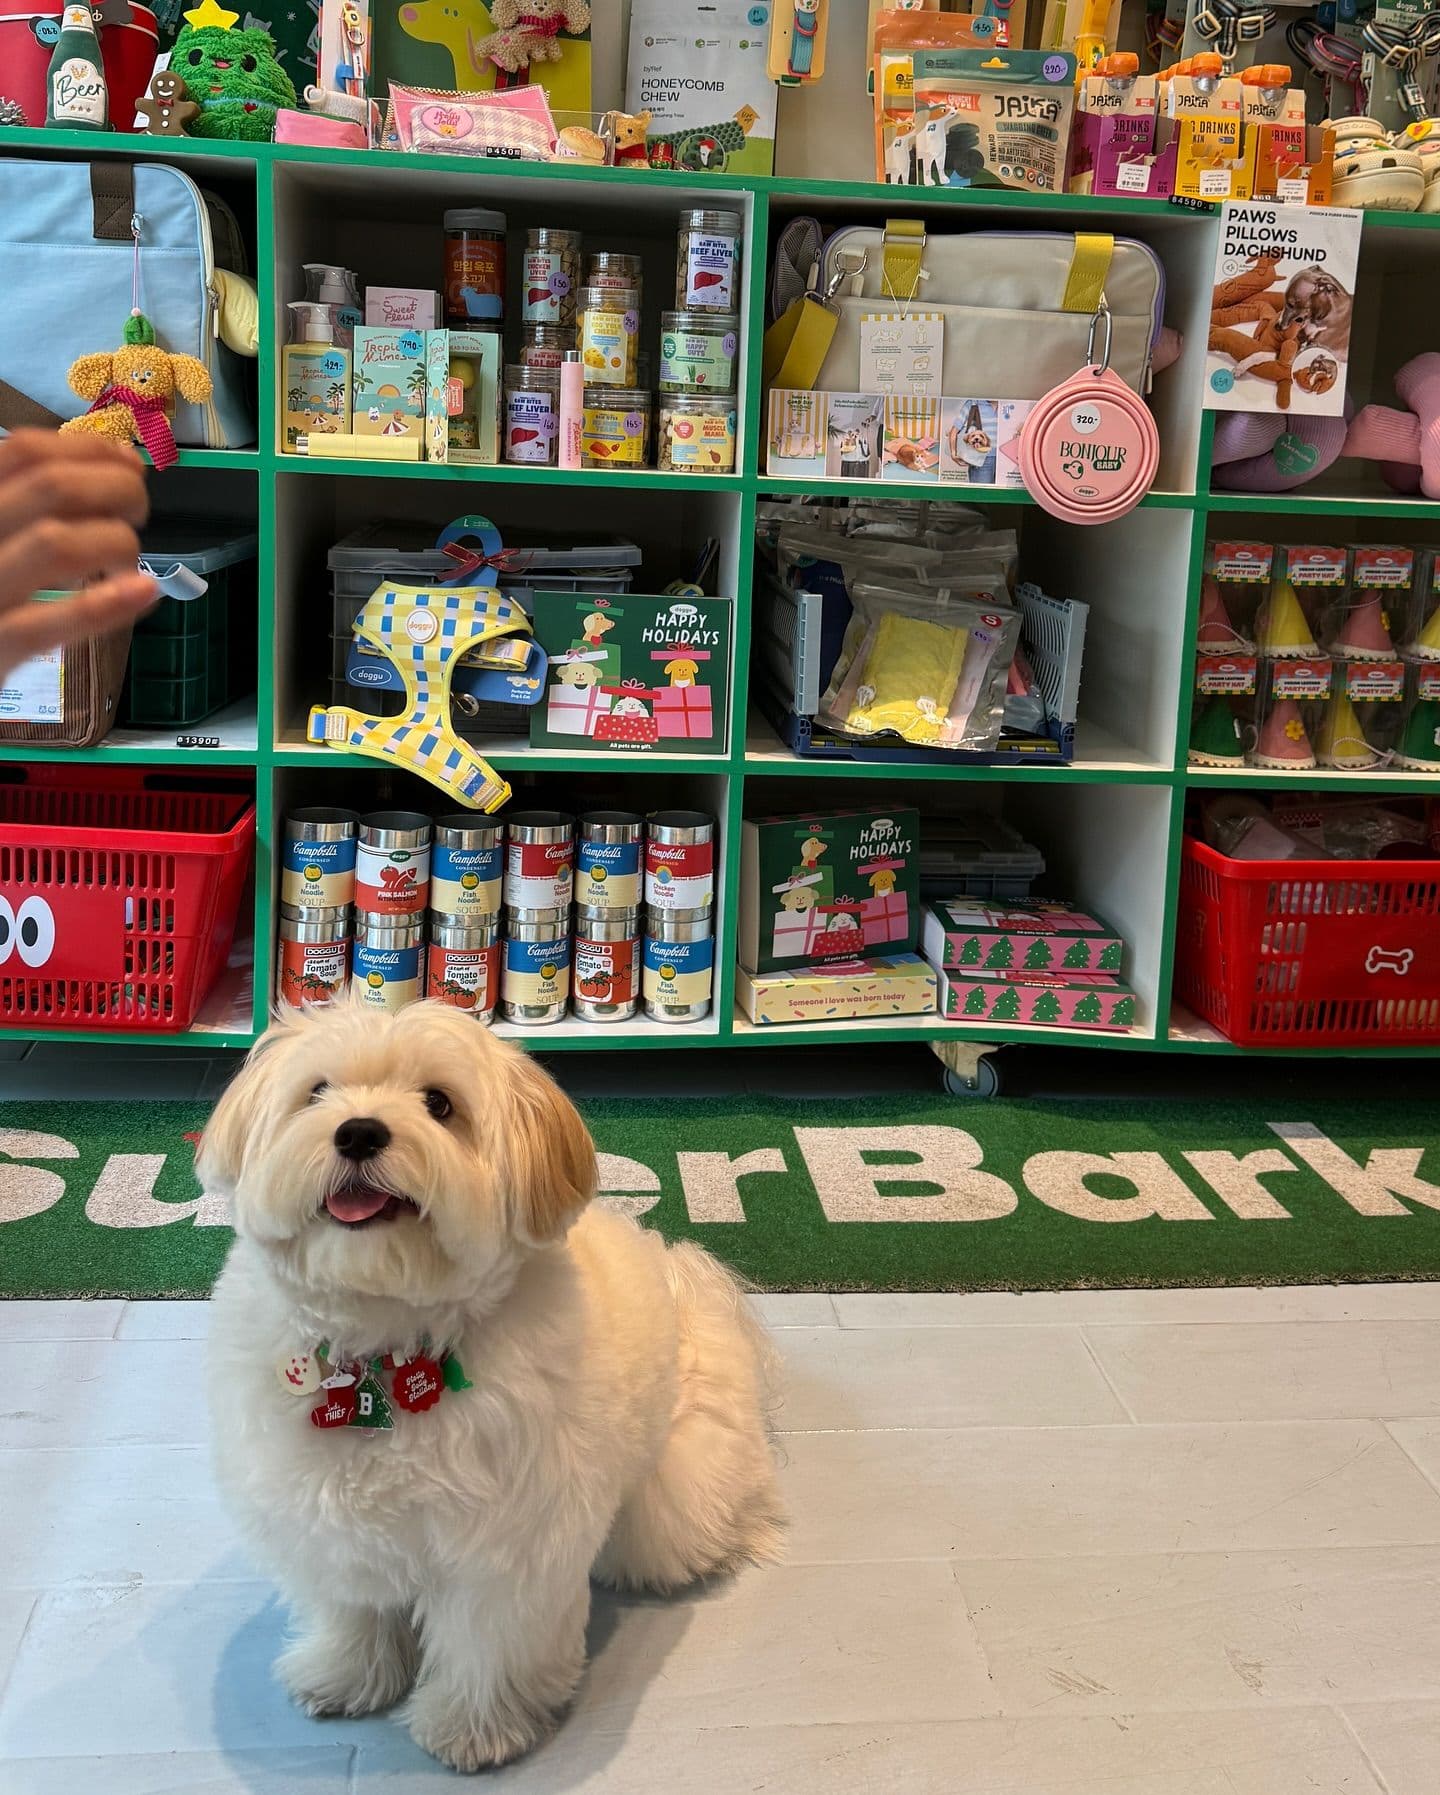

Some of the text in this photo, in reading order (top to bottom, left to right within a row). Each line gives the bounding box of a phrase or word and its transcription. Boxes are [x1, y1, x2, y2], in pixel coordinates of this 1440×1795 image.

[641, 78, 725, 92] HONEYCOMB
[58, 76, 104, 106] Beer
[641, 91, 680, 102] CHEW
[1200, 122, 1236, 135] DRINKS
[1228, 208, 1276, 225] PAWS
[1226, 225, 1298, 243] PILLOWS
[691, 247, 733, 258] BEEF LIVER
[1224, 242, 1327, 262] DACHSHUND
[461, 274, 486, 283] 소고기
[528, 359, 561, 368] SALMO
[526, 405, 549, 413] LIVER
[1060, 441, 1127, 463] BONJOUR
[1096, 461, 1119, 470] BABY
[655, 612, 707, 629] HAPPY
[986, 615, 998, 626] S
[408, 620, 433, 634] doggu
[642, 628, 720, 646] HOLIDAYS
[357, 669, 384, 682] doggu
[859, 825, 902, 844] HAPPY
[849, 839, 913, 861] HOLIDAYS
[300, 888, 324, 897] Noodle
[588, 888, 609, 897] Noodle
[653, 883, 676, 892] Chicken
[654, 890, 674, 898] Noodle
[457, 897, 481, 905] Noodle
[306, 947, 338, 955] DOGGU
[306, 963, 338, 972] Tomato
[447, 970, 478, 979] Tomato
[460, 977, 478, 985] Soup
[538, 986, 559, 994] Noodle
[656, 987, 678, 995] Noodle
[364, 995, 386, 1003] Noodle
[788, 998, 824, 1006] Someone
[829, 997, 846, 1005] love
[846, 996, 862, 1004] was
[863, 994, 882, 1002] born
[883, 993, 906, 1003] today
[358, 1392, 373, 1416] B
[325, 1407, 346, 1422] THIEF
